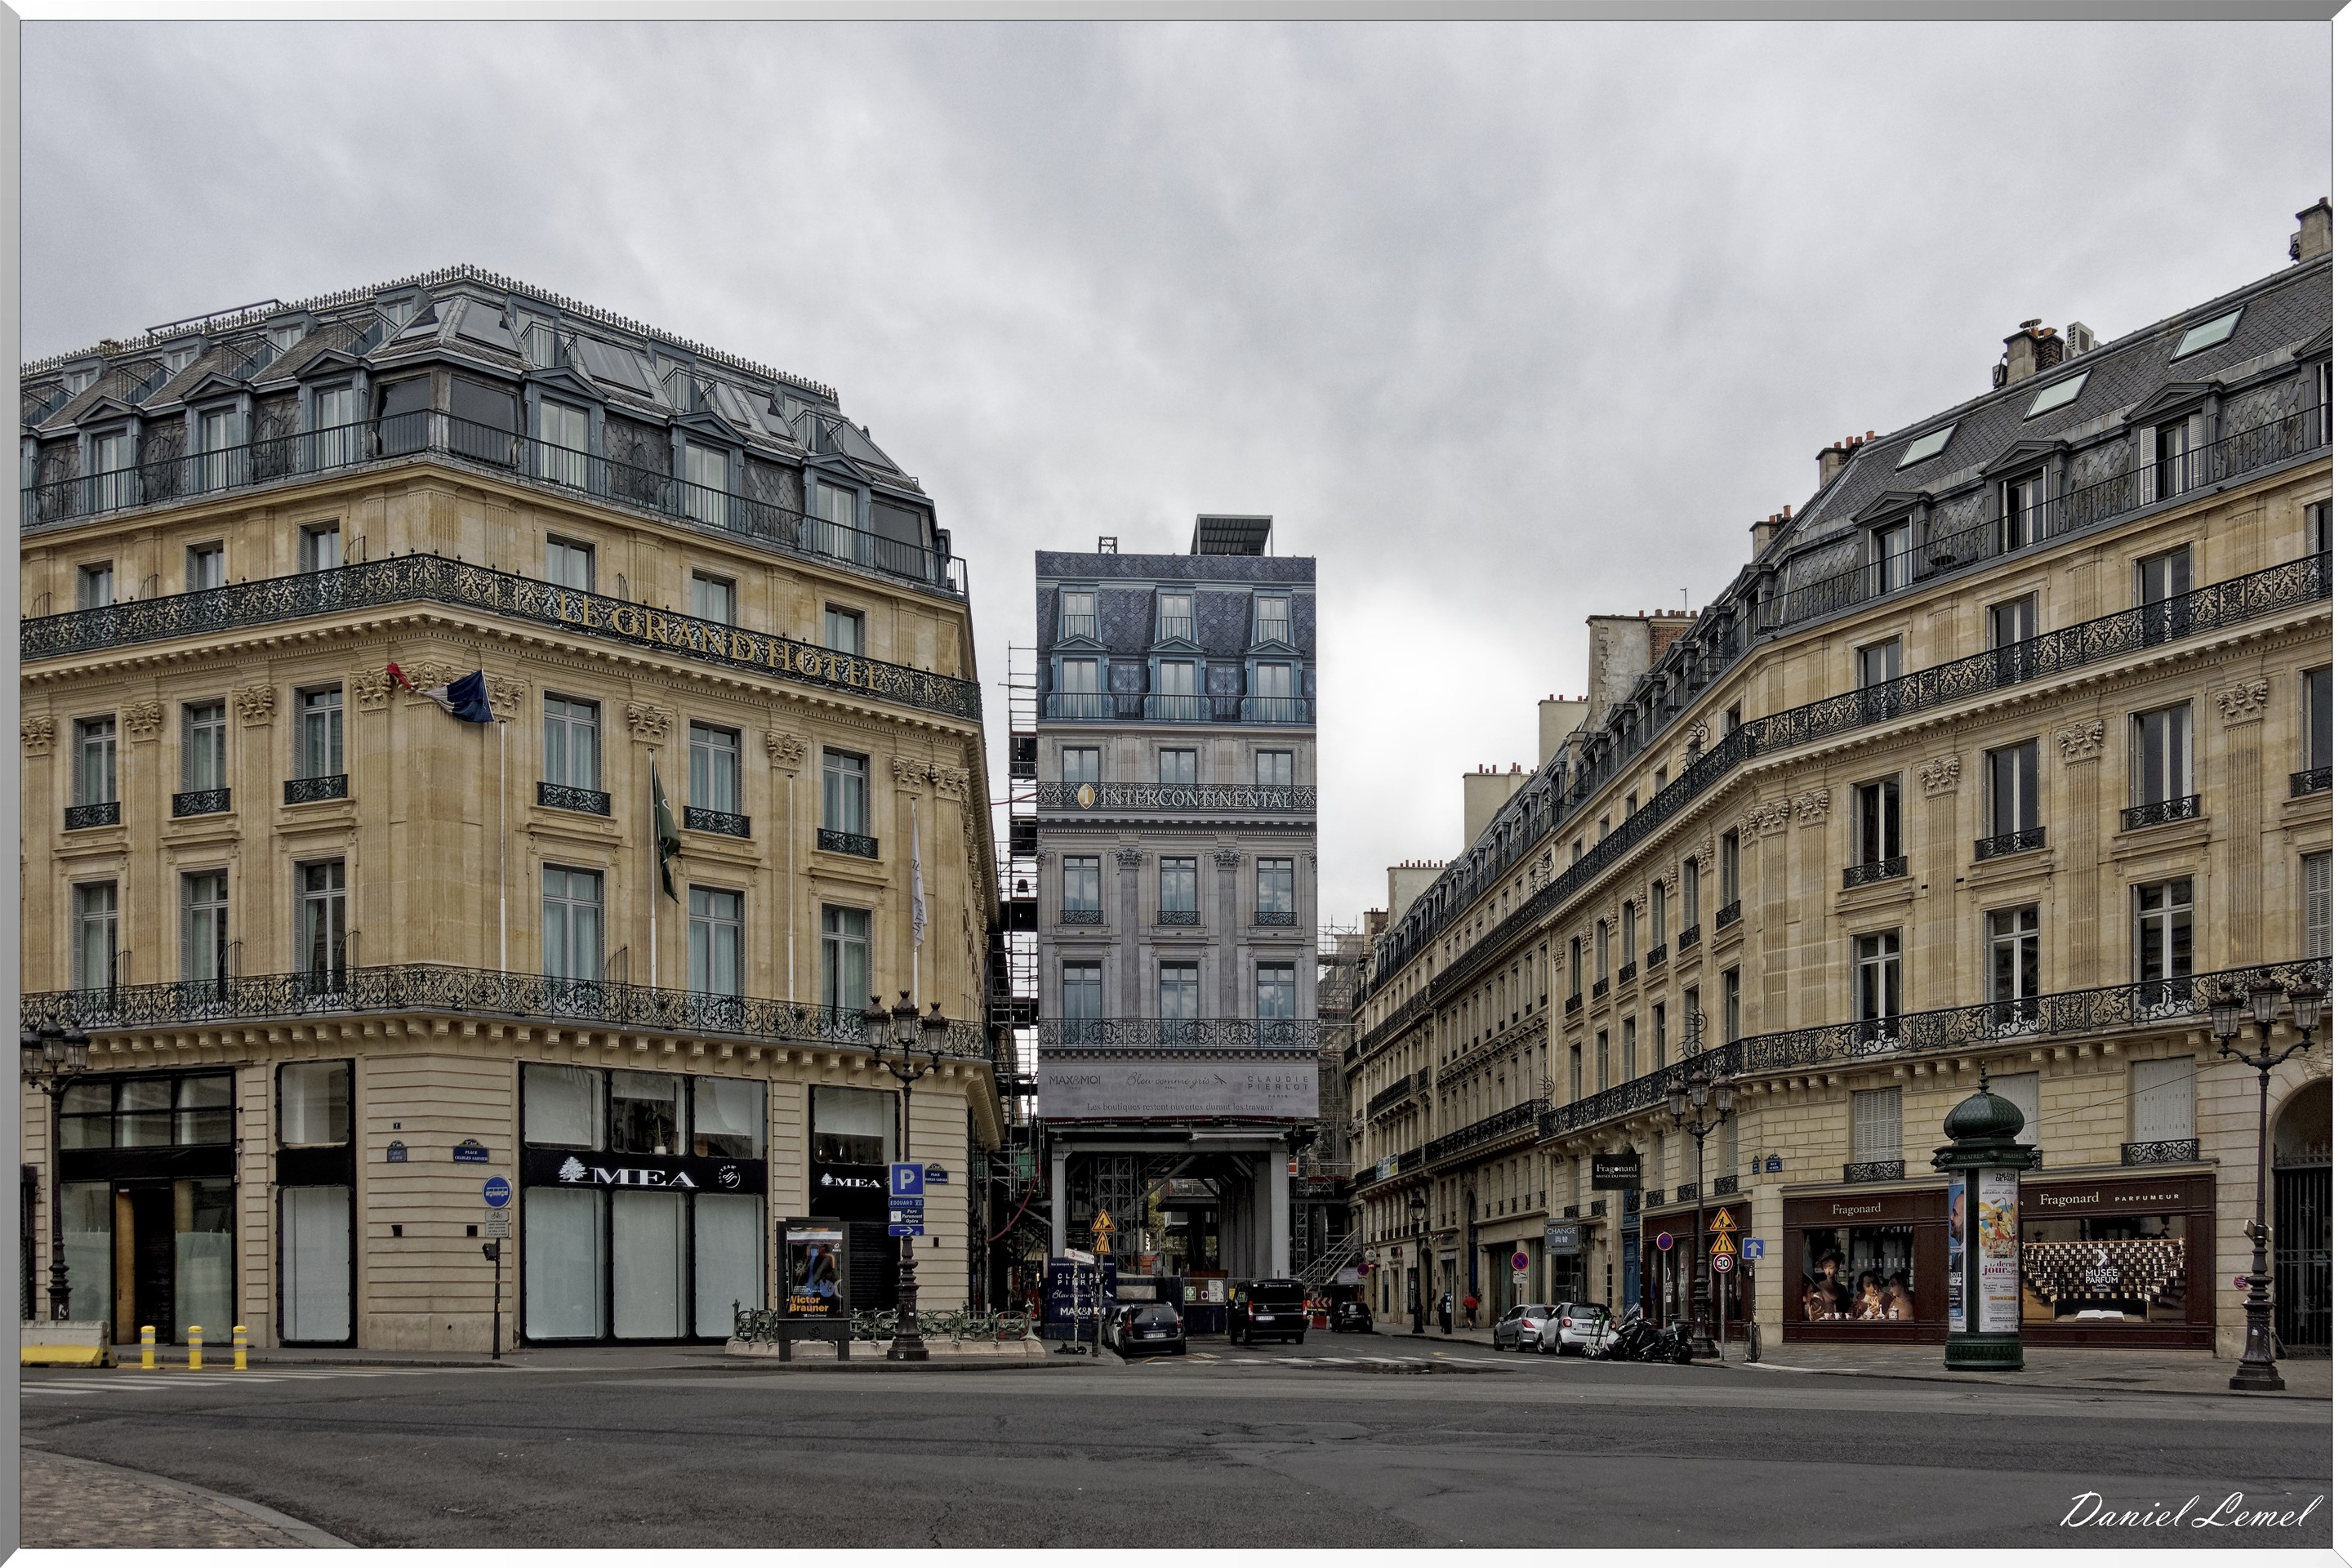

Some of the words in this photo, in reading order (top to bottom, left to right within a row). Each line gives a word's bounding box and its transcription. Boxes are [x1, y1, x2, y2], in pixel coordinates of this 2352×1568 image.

[559, 592, 602, 628] LE
[612, 608, 755, 662] GRAND
[768, 641, 884, 691] HOTEL
[1049, 1075, 1101, 1085] MAX&MOI
[1126, 1071, 1152, 1086] Bleu
[1189, 1076, 1210, 1089] gris
[1087, 1102, 1101, 1111] Les
[1102, 1102, 1141, 1112] boutiques
[1205, 1102, 1231, 1111] durant
[1232, 1102, 1244, 1111] les
[1597, 1163, 1637, 1174] Fragonard
[589, 1167, 700, 1187] MEA
[900, 1169, 915, 1190] P
[834, 1178, 883, 1188] MEA
[2039, 1192, 2100, 1208] Fragonard
[2114, 1193, 2180, 1202] PARFUMEUR
[1832, 1202, 1882, 1217] Fragonard
[1717, 1258, 1729, 1267] 30
[1981, 1265, 2007, 1276] jour
[2085, 1267, 2118, 1276] MUSÉE
[790, 1295, 821, 1304] Victor
[789, 1303, 829, 1312] Brauner
